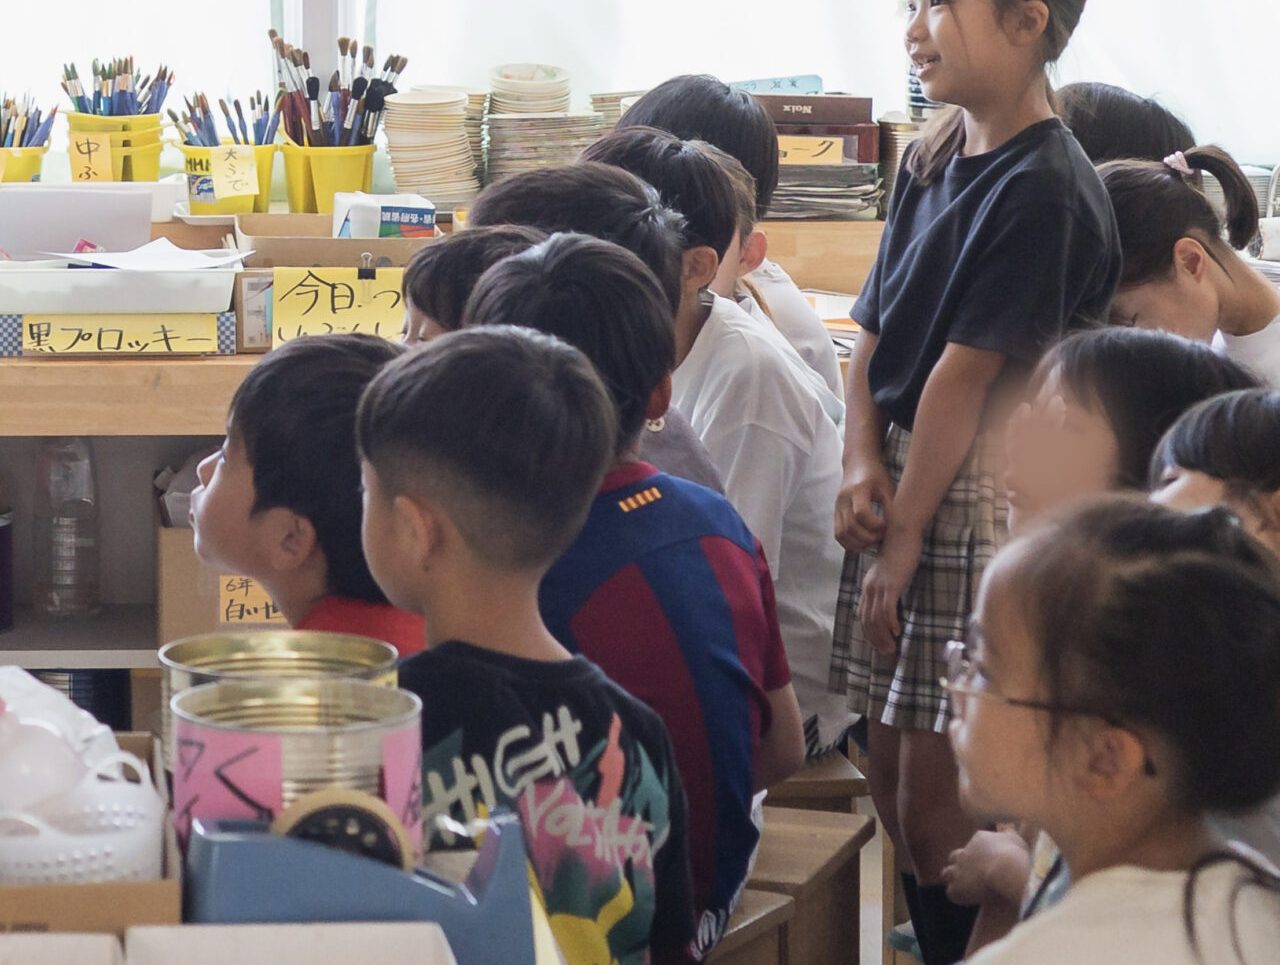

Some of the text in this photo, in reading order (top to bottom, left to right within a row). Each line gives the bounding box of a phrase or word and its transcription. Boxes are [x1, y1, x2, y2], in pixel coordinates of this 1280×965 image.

[782, 104, 813, 114] Noix
[28, 322, 213, 353] 黒プロッキー
[225, 577, 254, 597] 6年
[422, 704, 583, 845] HIGH
